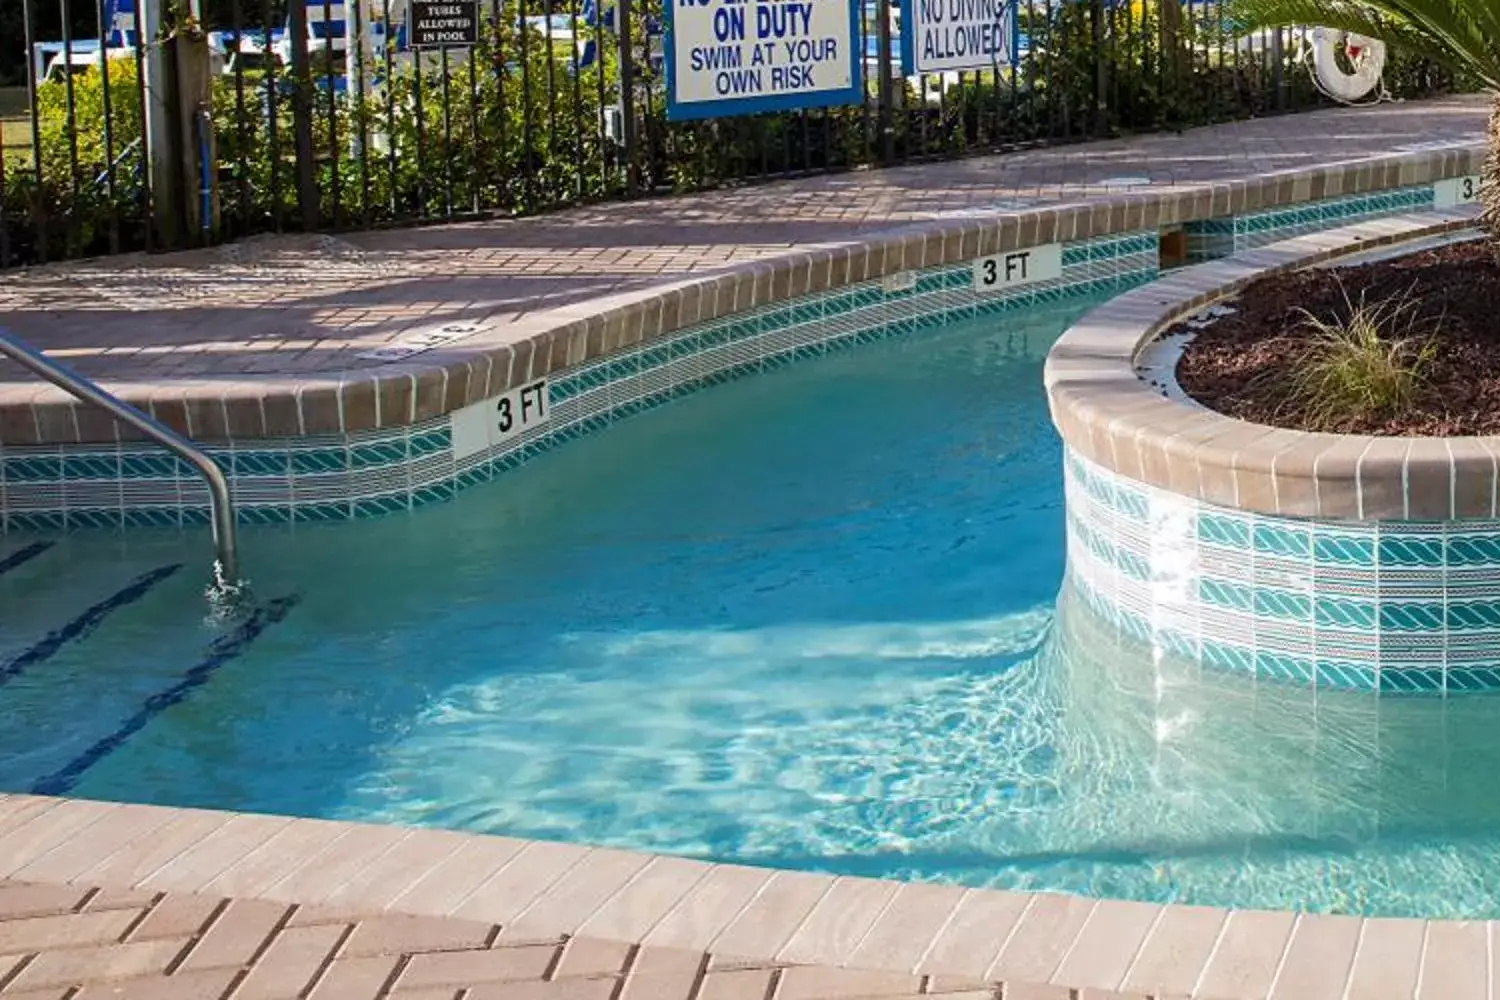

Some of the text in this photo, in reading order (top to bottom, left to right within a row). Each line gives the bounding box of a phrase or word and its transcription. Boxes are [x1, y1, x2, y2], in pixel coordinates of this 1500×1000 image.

[417, 18, 471, 29] ALLOWED
[427, 5, 462, 16] TUBES
[713, 3, 814, 42] ON DUTY
[423, 31, 467, 42] IN POOL
[923, 22, 1003, 60] ALLOWED
[690, 38, 838, 71] SWIM AT YOUR
[715, 64, 815, 95] OWN RISK
[1463, 178, 1473, 199] 3
[983, 252, 1030, 286] 3 FT
[497, 381, 545, 432] 3 FT
